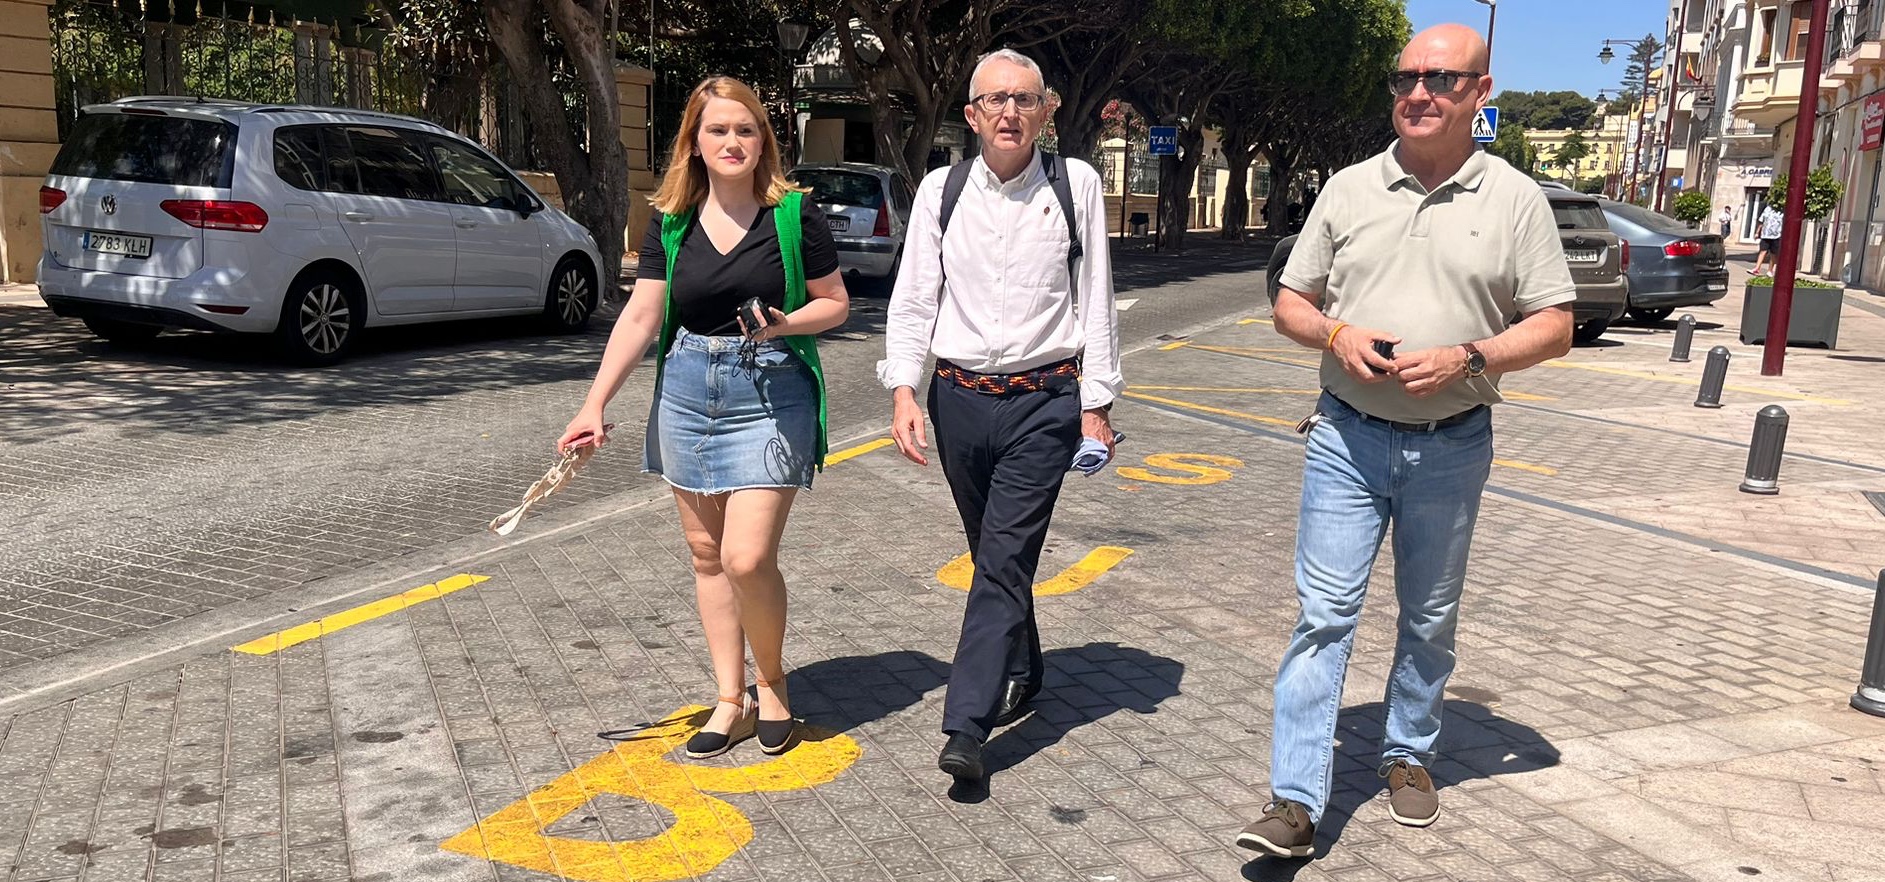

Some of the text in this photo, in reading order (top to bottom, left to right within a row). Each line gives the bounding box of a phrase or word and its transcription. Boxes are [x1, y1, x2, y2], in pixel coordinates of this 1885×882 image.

[1151, 135, 1175, 145] TAXI
[90, 235, 147, 254] 2783 KLH
